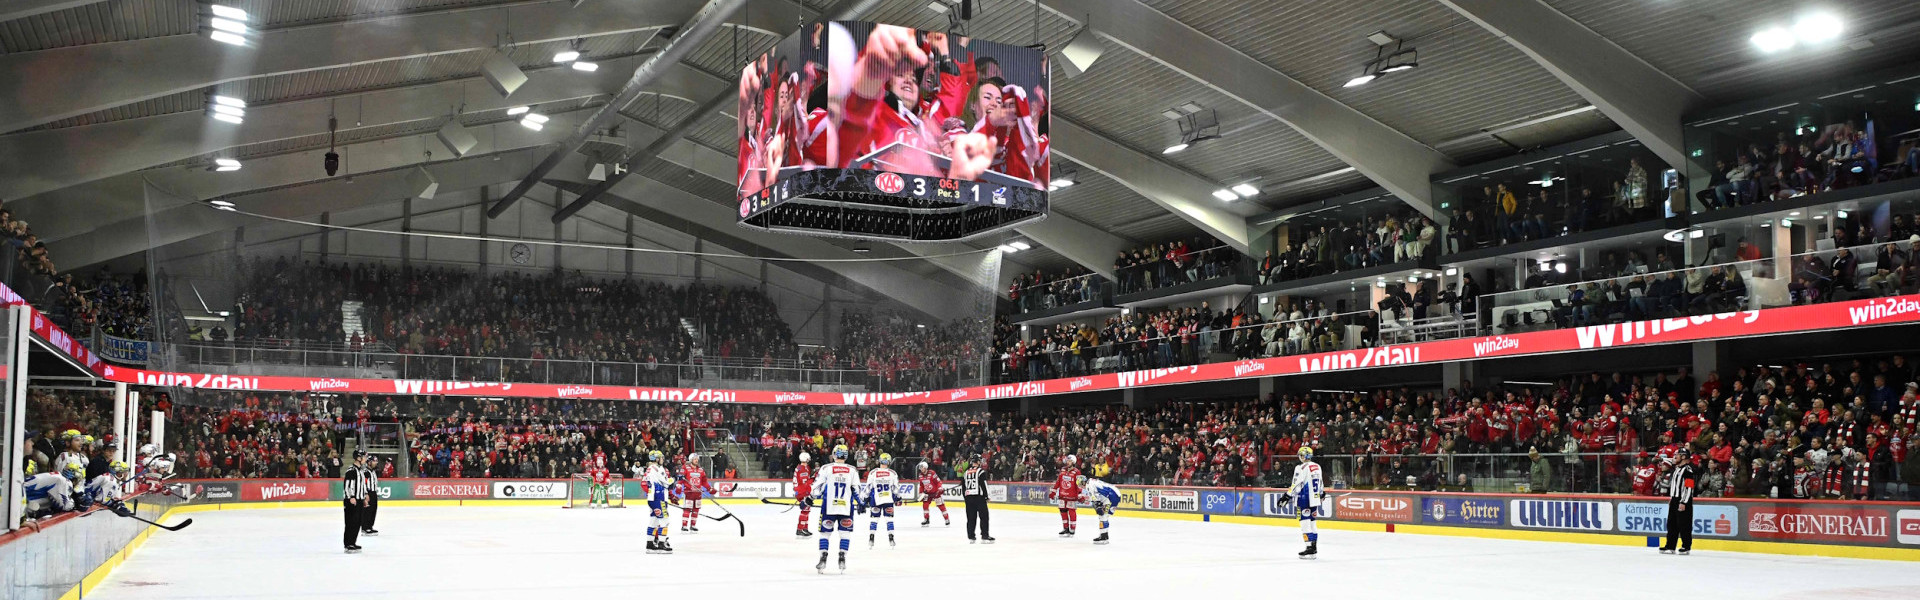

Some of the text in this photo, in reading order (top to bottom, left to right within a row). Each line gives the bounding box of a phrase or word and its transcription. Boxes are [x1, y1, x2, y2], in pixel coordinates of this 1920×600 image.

[880, 173, 900, 192] KAC
[913, 178, 926, 196] 3
[773, 185, 778, 203] 1
[937, 189, 960, 199] Per. 3
[971, 184, 980, 202] 1
[752, 195, 758, 212] 3
[1849, 298, 1920, 325] win2day
[1473, 336, 1519, 357] win2day
[1234, 360, 1265, 377] win2day
[310, 379, 349, 391] win2day
[557, 387, 592, 397] win2day
[1069, 377, 1092, 391] win2day
[775, 392, 805, 402] win2day
[261, 483, 306, 500] win2day
[432, 485, 488, 496] GENERALI
[519, 483, 553, 494] ocay
[834, 482, 846, 498] 17
[967, 479, 976, 490] 76
[1121, 494, 1142, 506] RAL
[1161, 497, 1195, 511] Baumit
[1348, 497, 1398, 511] STW
[1460, 500, 1500, 521] Hirter
[1519, 500, 1601, 529] LILIHILL
[1625, 504, 1663, 515] Kärntner
[1625, 516, 1713, 534] SPARSE
[1780, 513, 1888, 537] GENERALI
